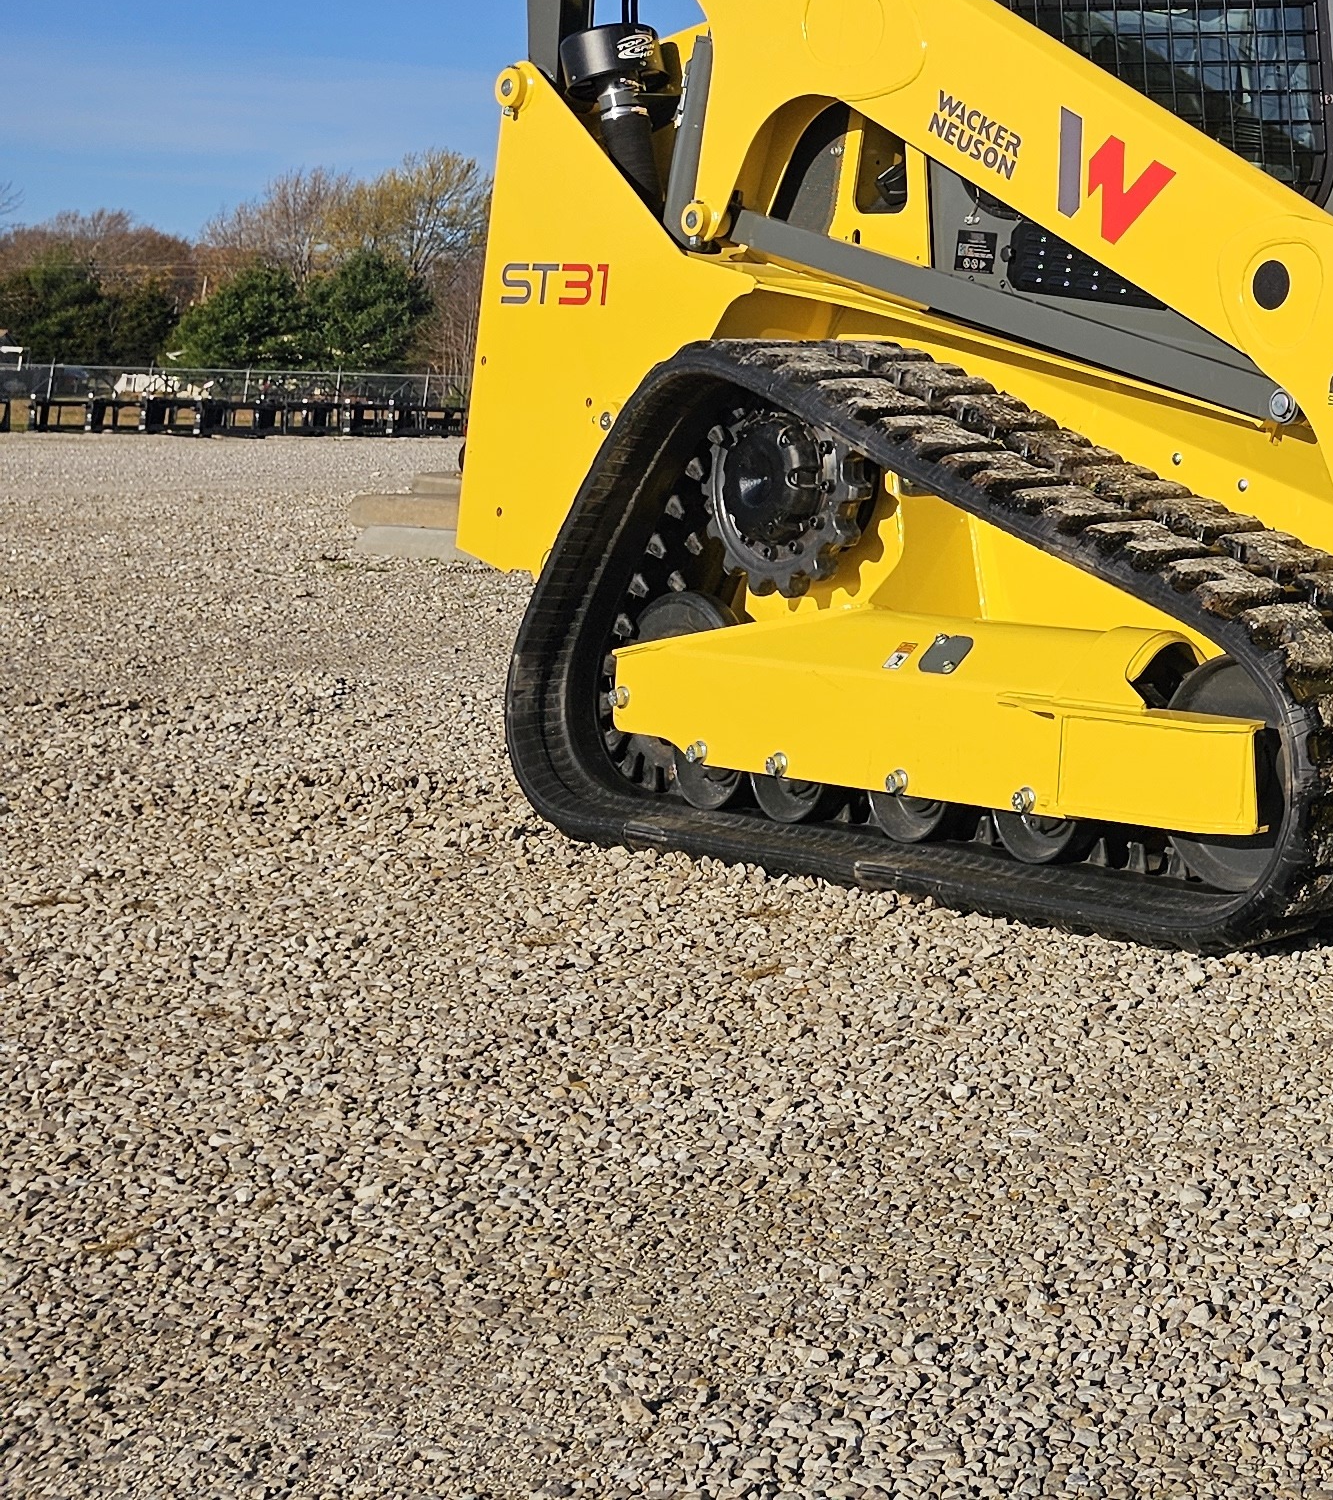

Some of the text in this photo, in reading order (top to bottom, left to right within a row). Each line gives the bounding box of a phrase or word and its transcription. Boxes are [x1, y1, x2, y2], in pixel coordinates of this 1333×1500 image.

[617, 39, 642, 51] TOP
[928, 112, 1017, 180] NEUSON
[939, 89, 1022, 158] WACKER
[501, 263, 609, 305] ST31
